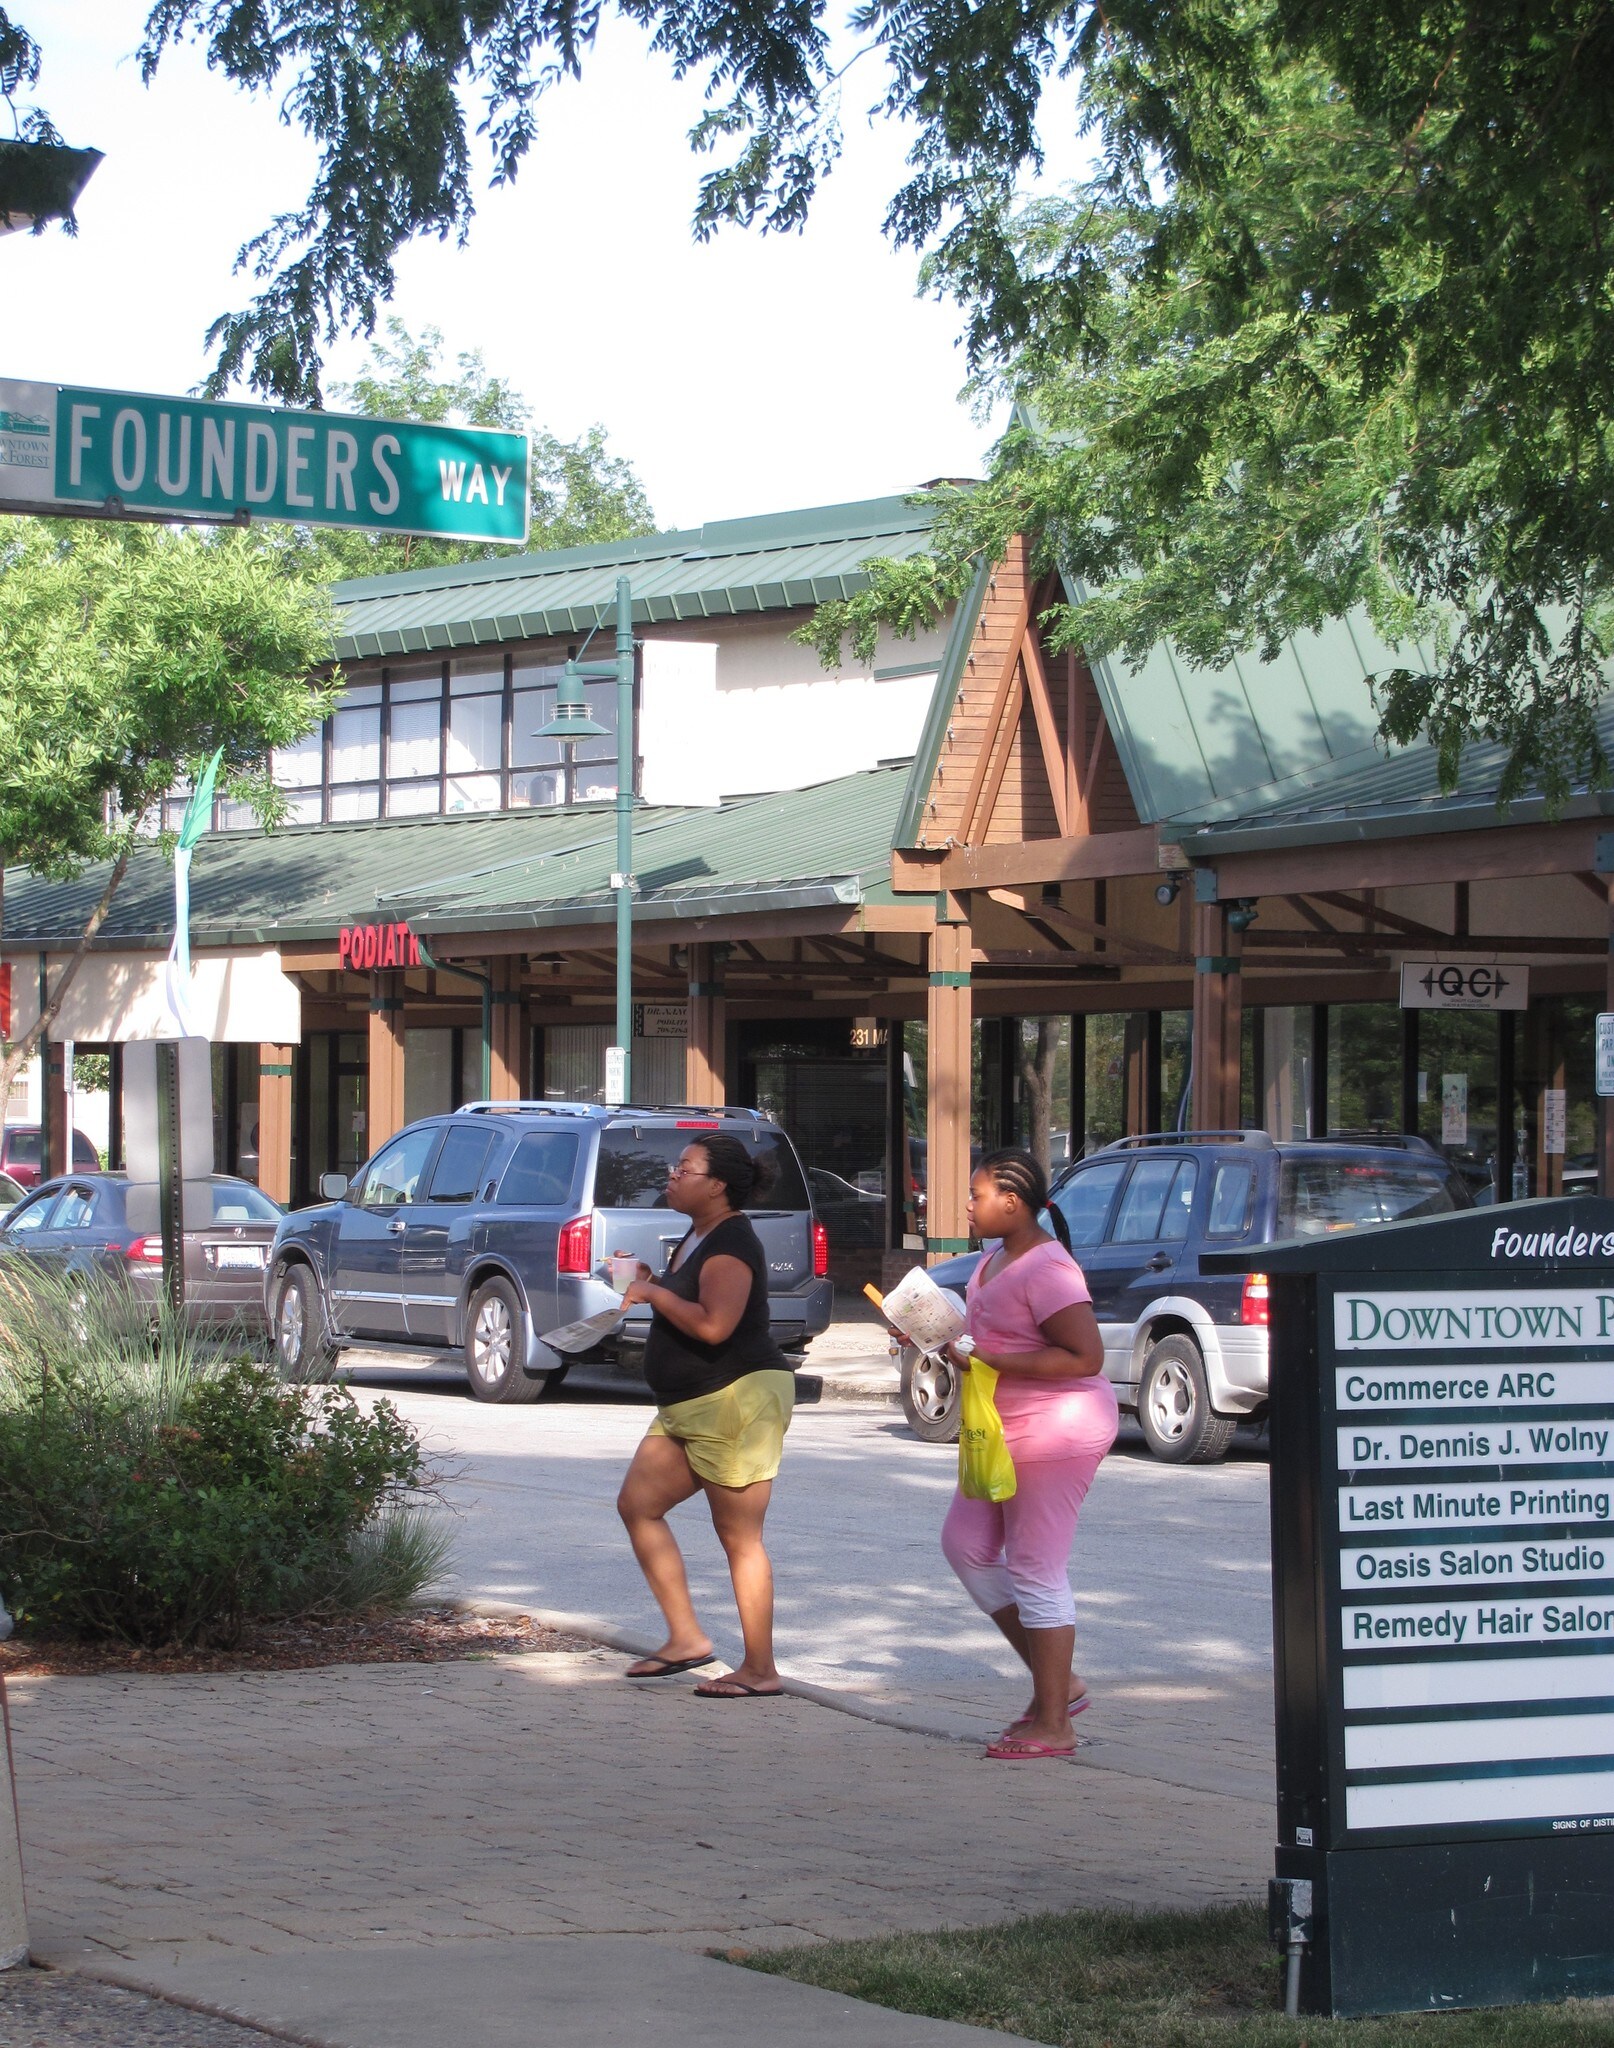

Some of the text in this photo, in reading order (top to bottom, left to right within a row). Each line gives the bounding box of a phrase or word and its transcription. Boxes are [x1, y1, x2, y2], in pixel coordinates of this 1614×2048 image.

[70, 404, 513, 516] FOUNDERS WAY
[1438, 966, 1492, 998] QC
[850, 1029, 868, 1045] 231
[1491, 1226, 1614, 1257] Founders
[1347, 1299, 1584, 1341] DOWNTOWN
[1345, 1372, 1556, 1402] Commerce ARC
[1353, 1426, 1609, 1462] Dr. Dennis J. Wolny
[1349, 1488, 1610, 1521] Last Minute Printing
[1356, 1545, 1605, 1580] Oasis Salon Studio
[1353, 1609, 1467, 1643] Remedy
[1477, 1606, 1533, 1635] Hair
[1552, 1817, 1614, 1830] SIGNS OF DISTI
